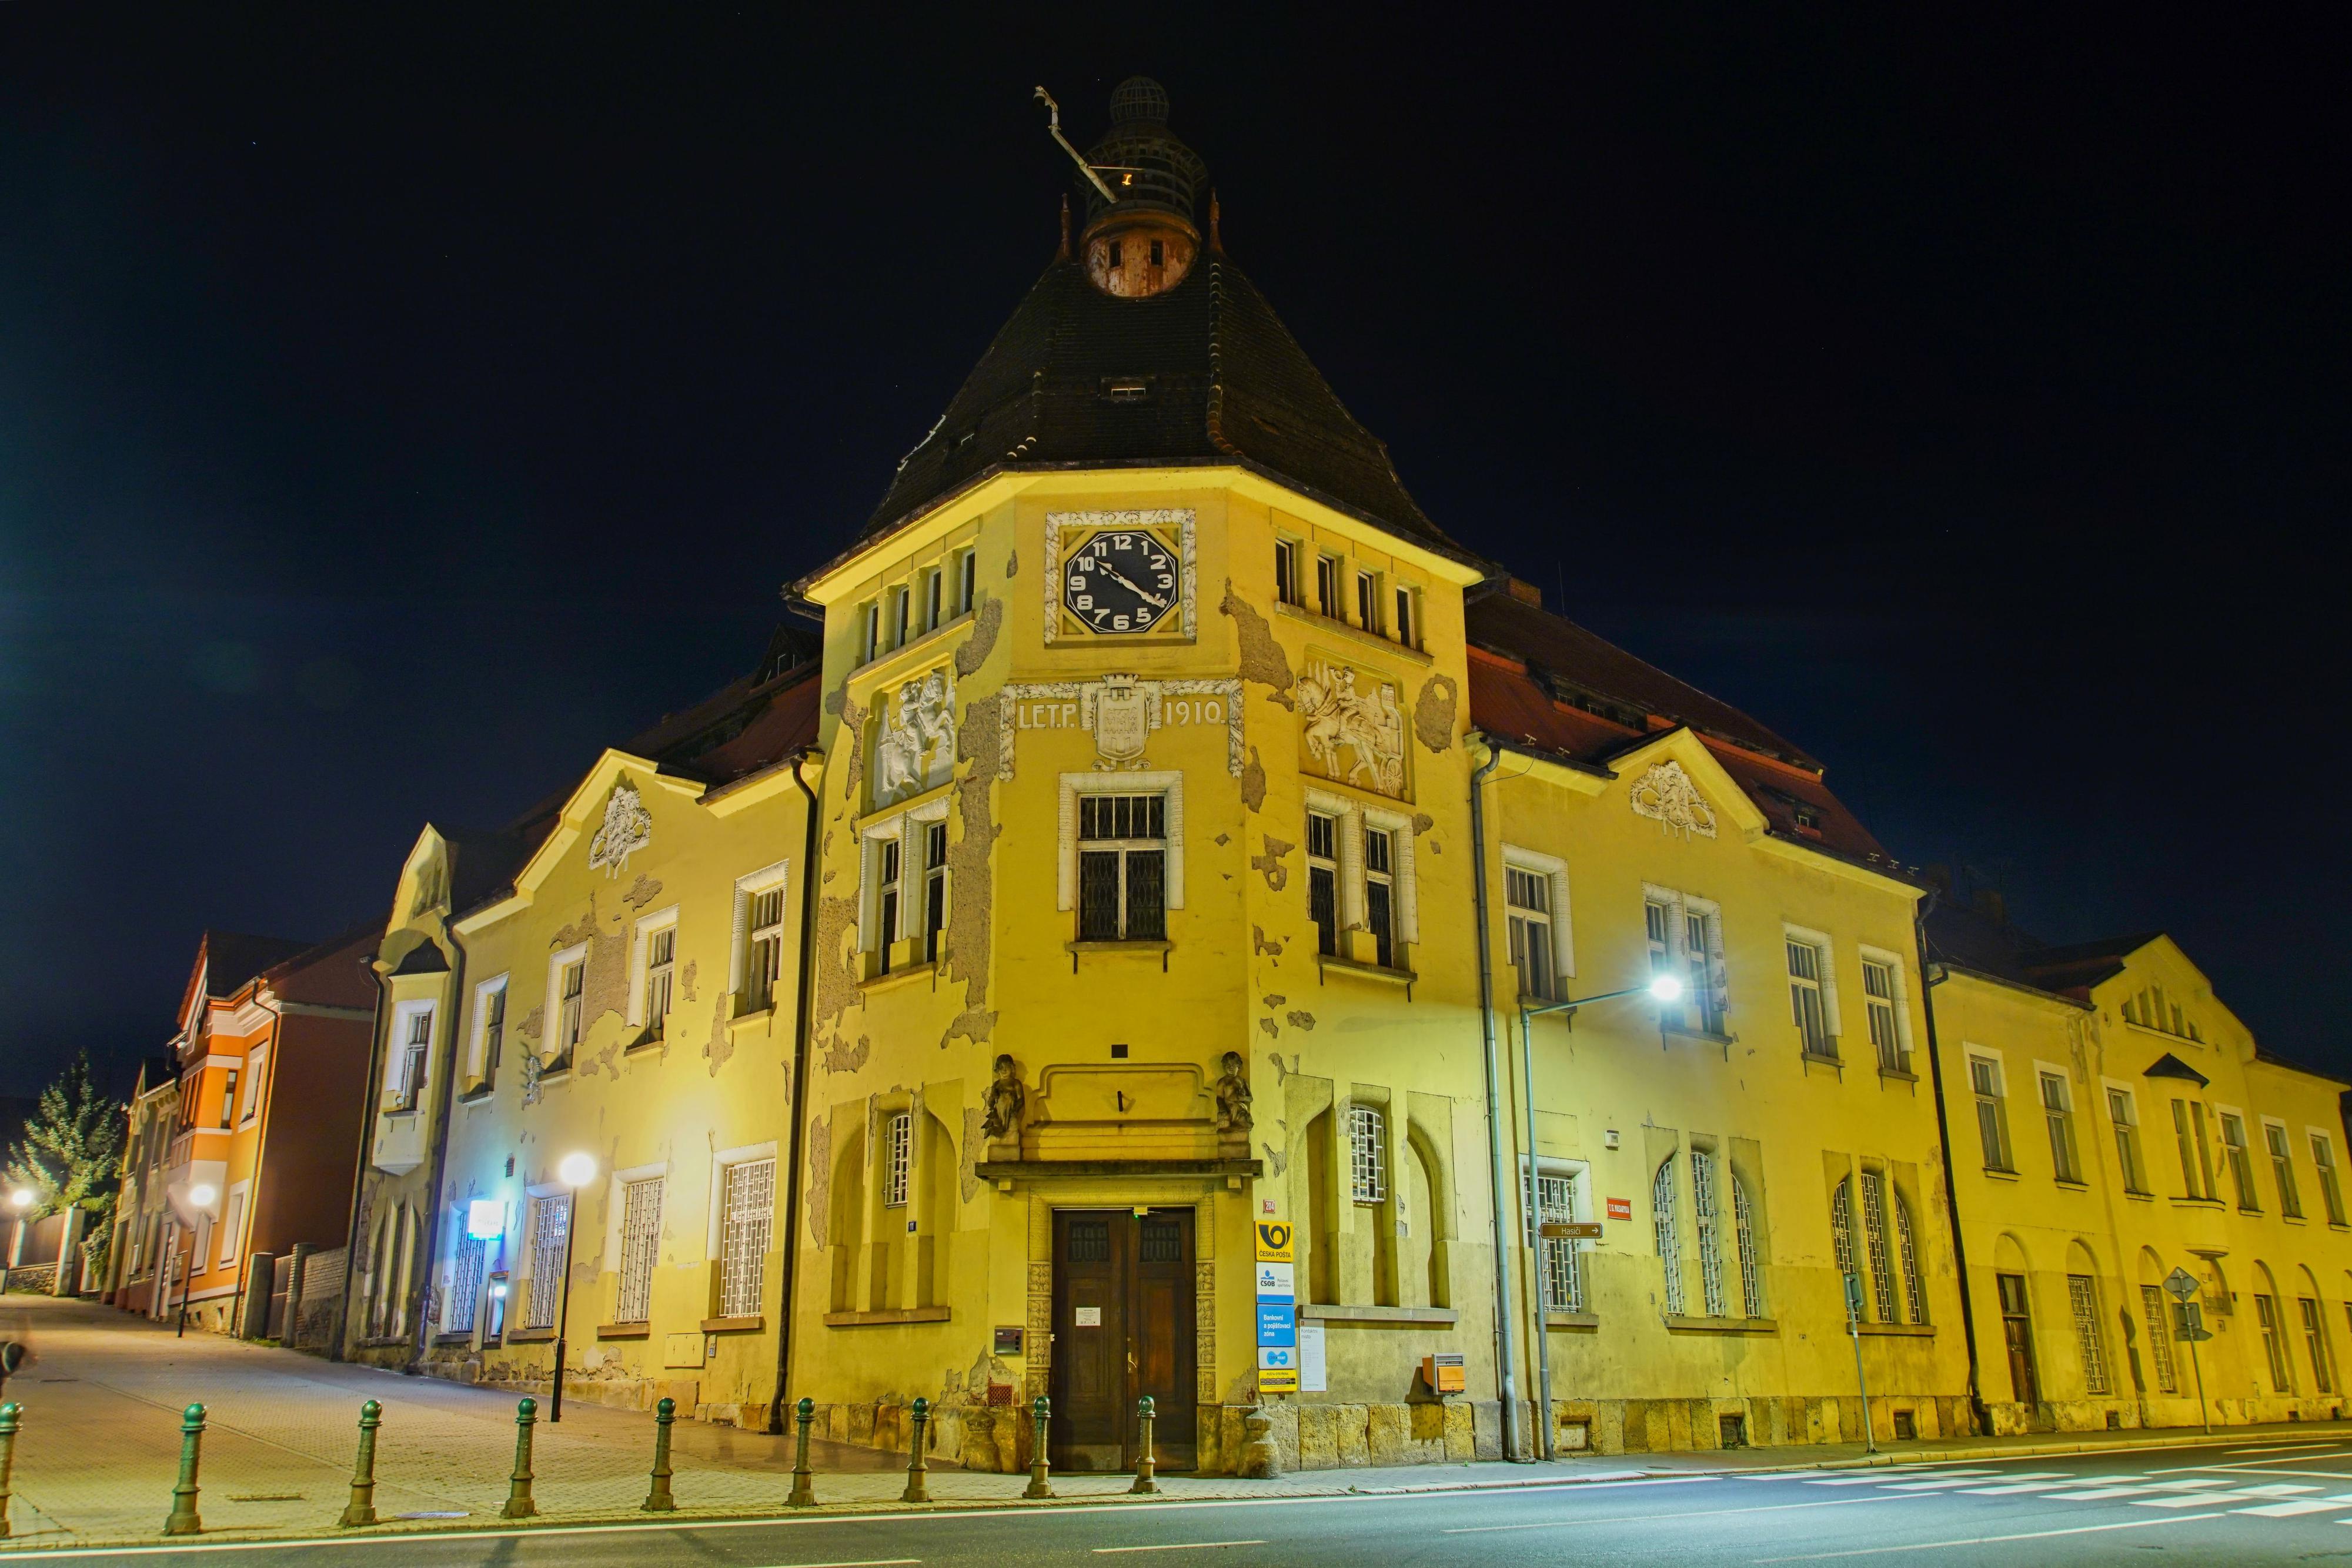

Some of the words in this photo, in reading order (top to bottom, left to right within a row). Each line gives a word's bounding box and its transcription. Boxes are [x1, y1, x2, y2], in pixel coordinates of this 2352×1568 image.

[1093, 541, 1107, 557] 11
[1112, 535, 1132, 550] 12
[1141, 541, 1148, 556] 1
[1077, 556, 1094, 571] 10
[1150, 554, 1166, 570] 2
[1070, 576, 1086, 591] 9
[1157, 574, 1173, 589] 3
[1077, 595, 1093, 610] 8
[1151, 593, 1167, 608] 4
[1094, 609, 1110, 624] 7
[1113, 615, 1130, 630] 6
[1135, 607, 1151, 623] 5
[1265, 1202, 1275, 1211] 204
[1615, 1204, 1630, 1214] MASARYKA
[910, 1222, 914, 1231] 11
[1561, 1226, 1581, 1235] Hasiči
